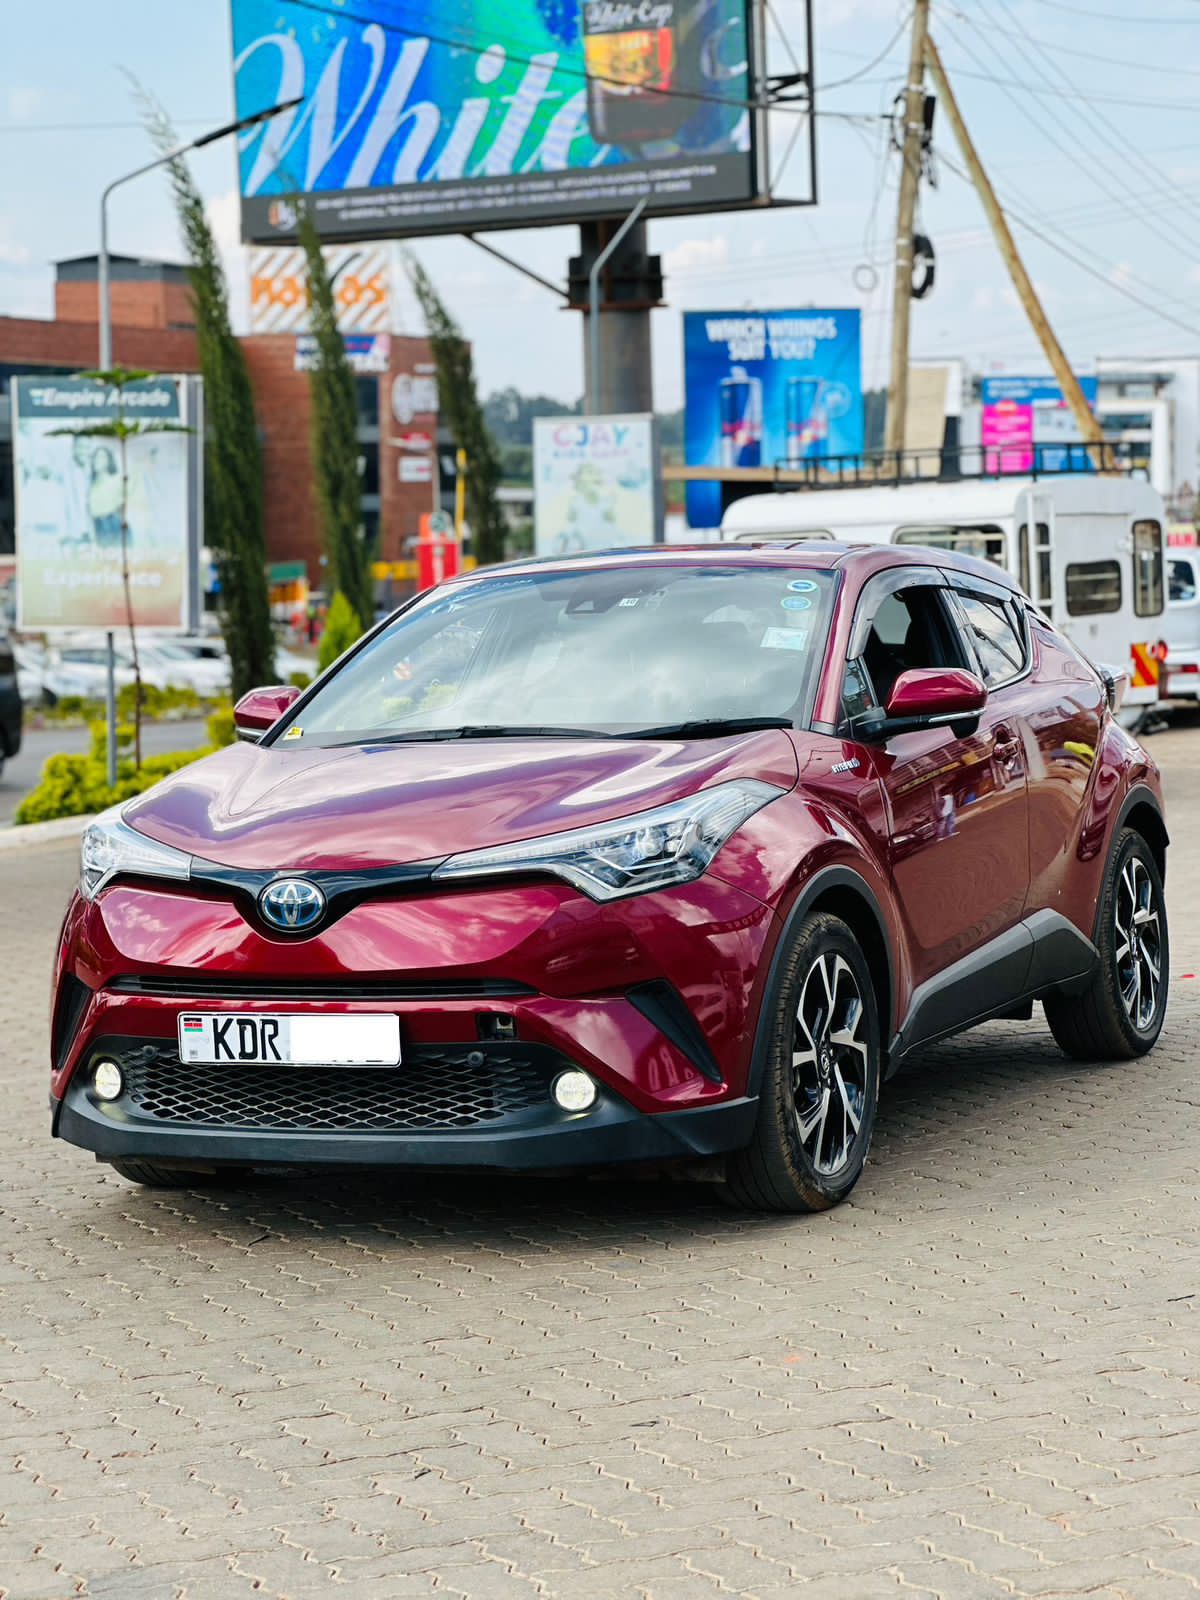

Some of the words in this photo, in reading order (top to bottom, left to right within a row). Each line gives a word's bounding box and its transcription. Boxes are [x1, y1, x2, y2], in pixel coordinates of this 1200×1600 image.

[234, 23, 611, 198] White
[705, 318, 766, 343] WHICH
[728, 338, 766, 361] SUIT
[769, 337, 817, 360] YOU?
[43, 387, 106, 410] Empire
[106, 387, 172, 408] Arcade
[212, 1018, 282, 1060] KDR
